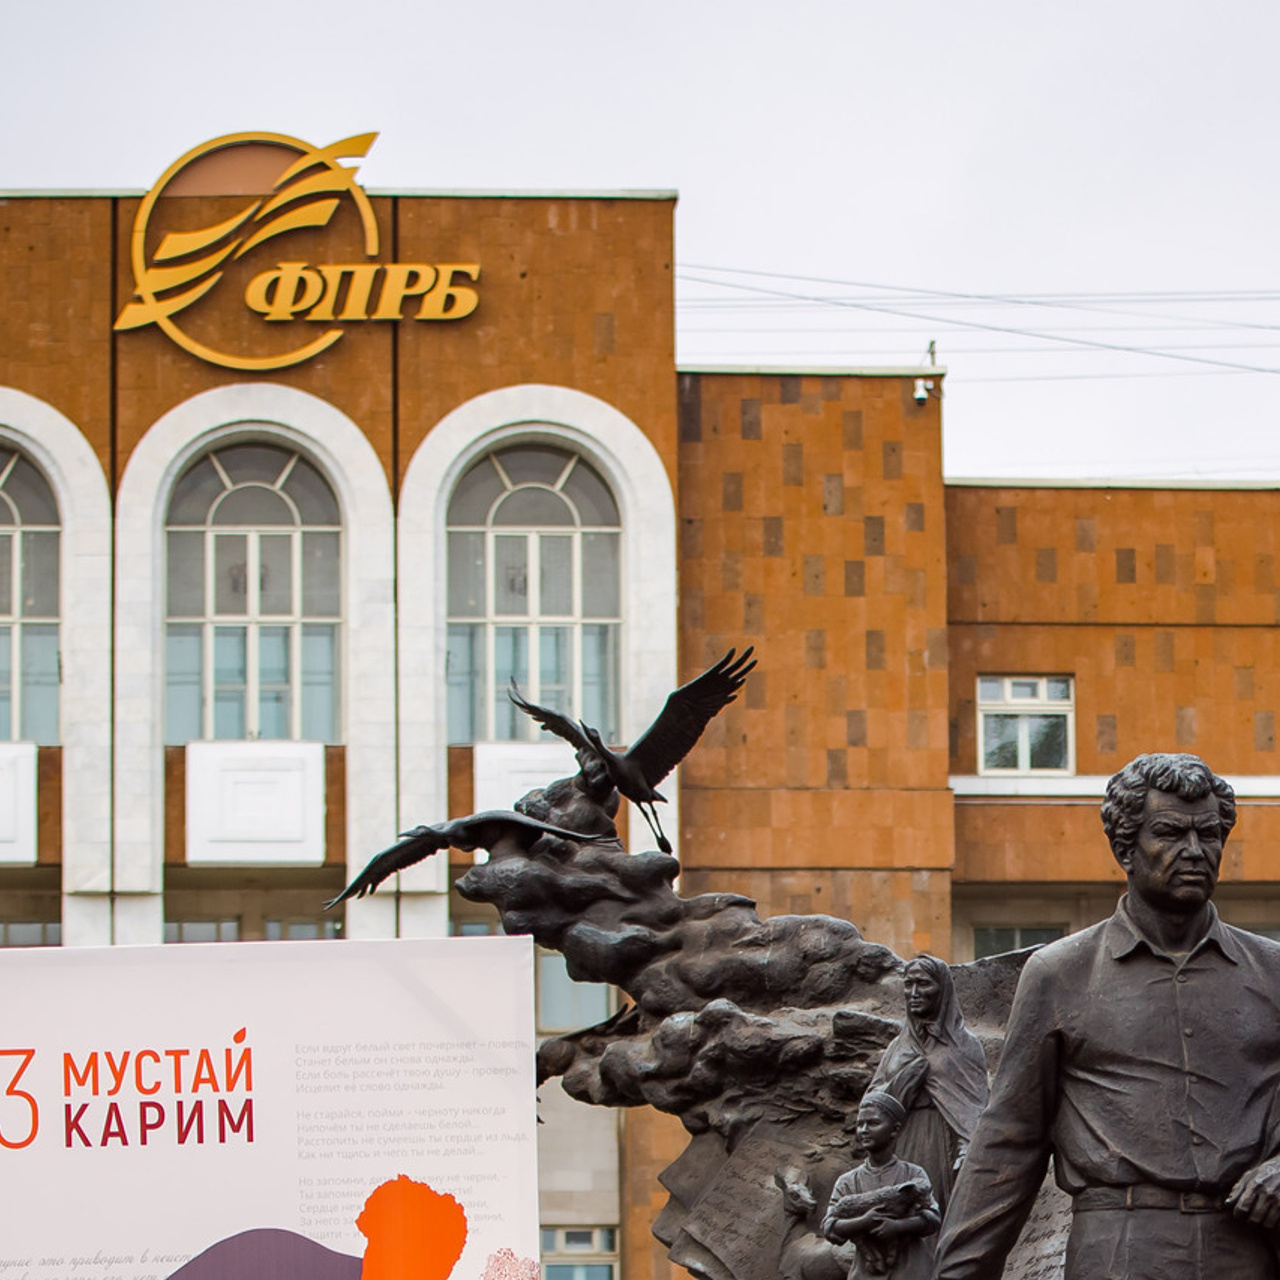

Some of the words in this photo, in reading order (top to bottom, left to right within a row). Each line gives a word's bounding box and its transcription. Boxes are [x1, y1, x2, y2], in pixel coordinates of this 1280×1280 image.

[245, 261, 482, 322] ФПРБ
[63, 1028, 254, 1097] МУСТАЙ
[64, 1099, 255, 1148] КАРИМ
